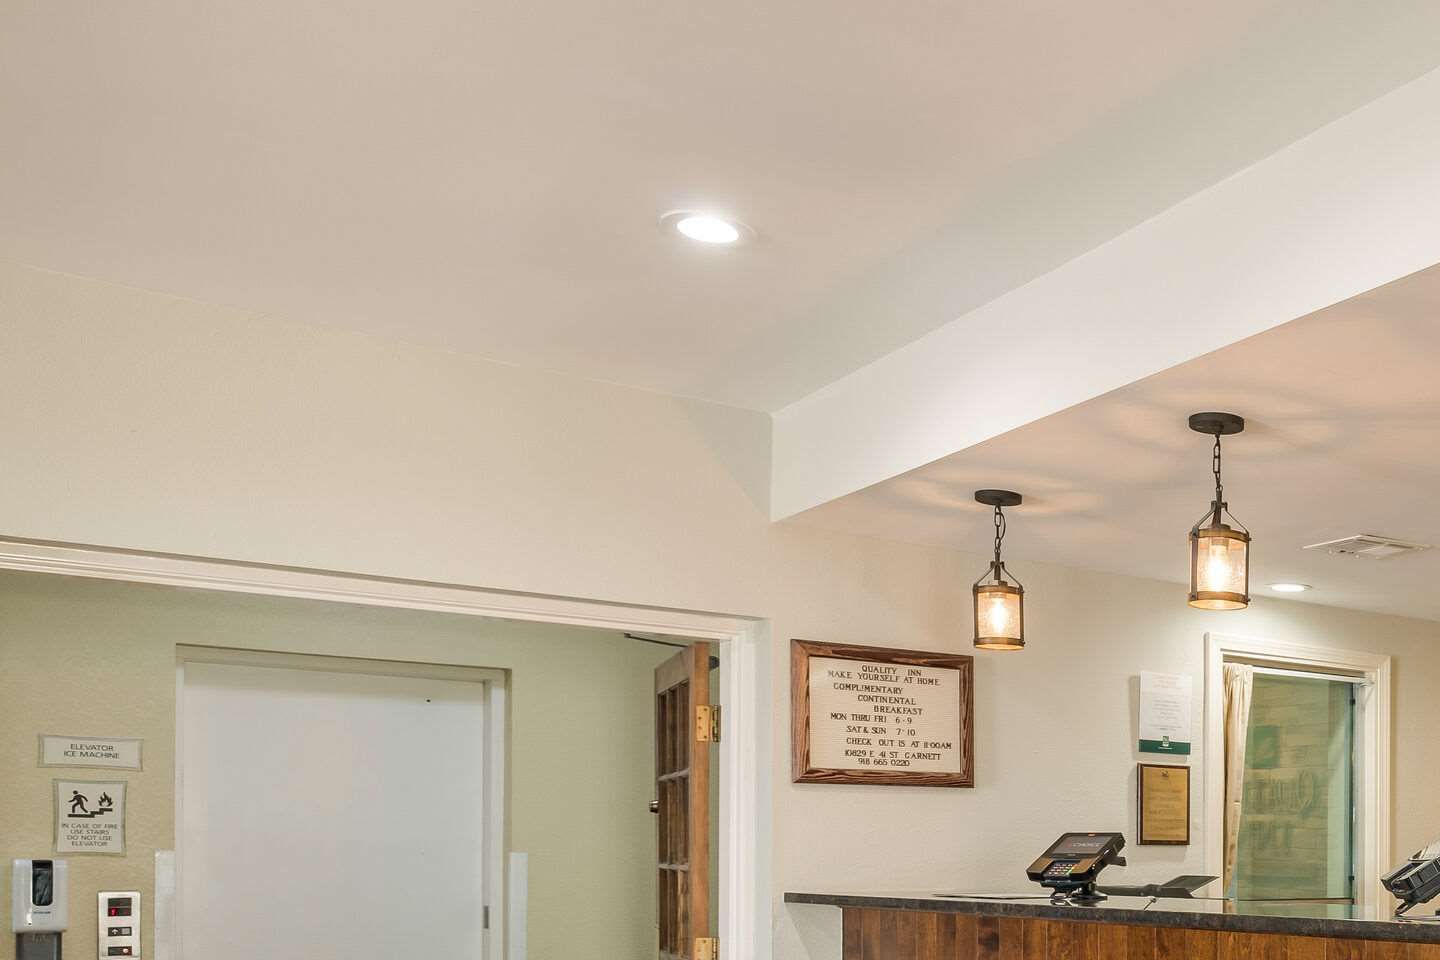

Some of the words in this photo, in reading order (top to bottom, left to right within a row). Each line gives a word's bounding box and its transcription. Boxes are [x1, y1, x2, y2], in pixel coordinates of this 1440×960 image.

[861, 664, 897, 675] QUALITY
[907, 668, 922, 676] INN
[857, 672, 900, 682] YOURSELF
[917, 677, 941, 686] HOME
[833, 682, 904, 694] COMPLIMENTARY
[857, 694, 917, 705] CONTINENTAL
[873, 705, 923, 715] BREAKFAST
[830, 712, 848, 721] MON
[851, 713, 871, 722] THRU
[874, 715, 887, 723] FRI
[846, 725, 861, 733] SAT
[871, 726, 887, 734] SUN
[70, 743, 114, 751] ELEVATOR
[846, 737, 872, 746] CHECK
[878, 738, 894, 747] OUT
[899, 739, 906, 747] IS
[911, 740, 920, 748] AT
[63, 750, 77, 758] ICE
[79, 751, 120, 760] MACHINE
